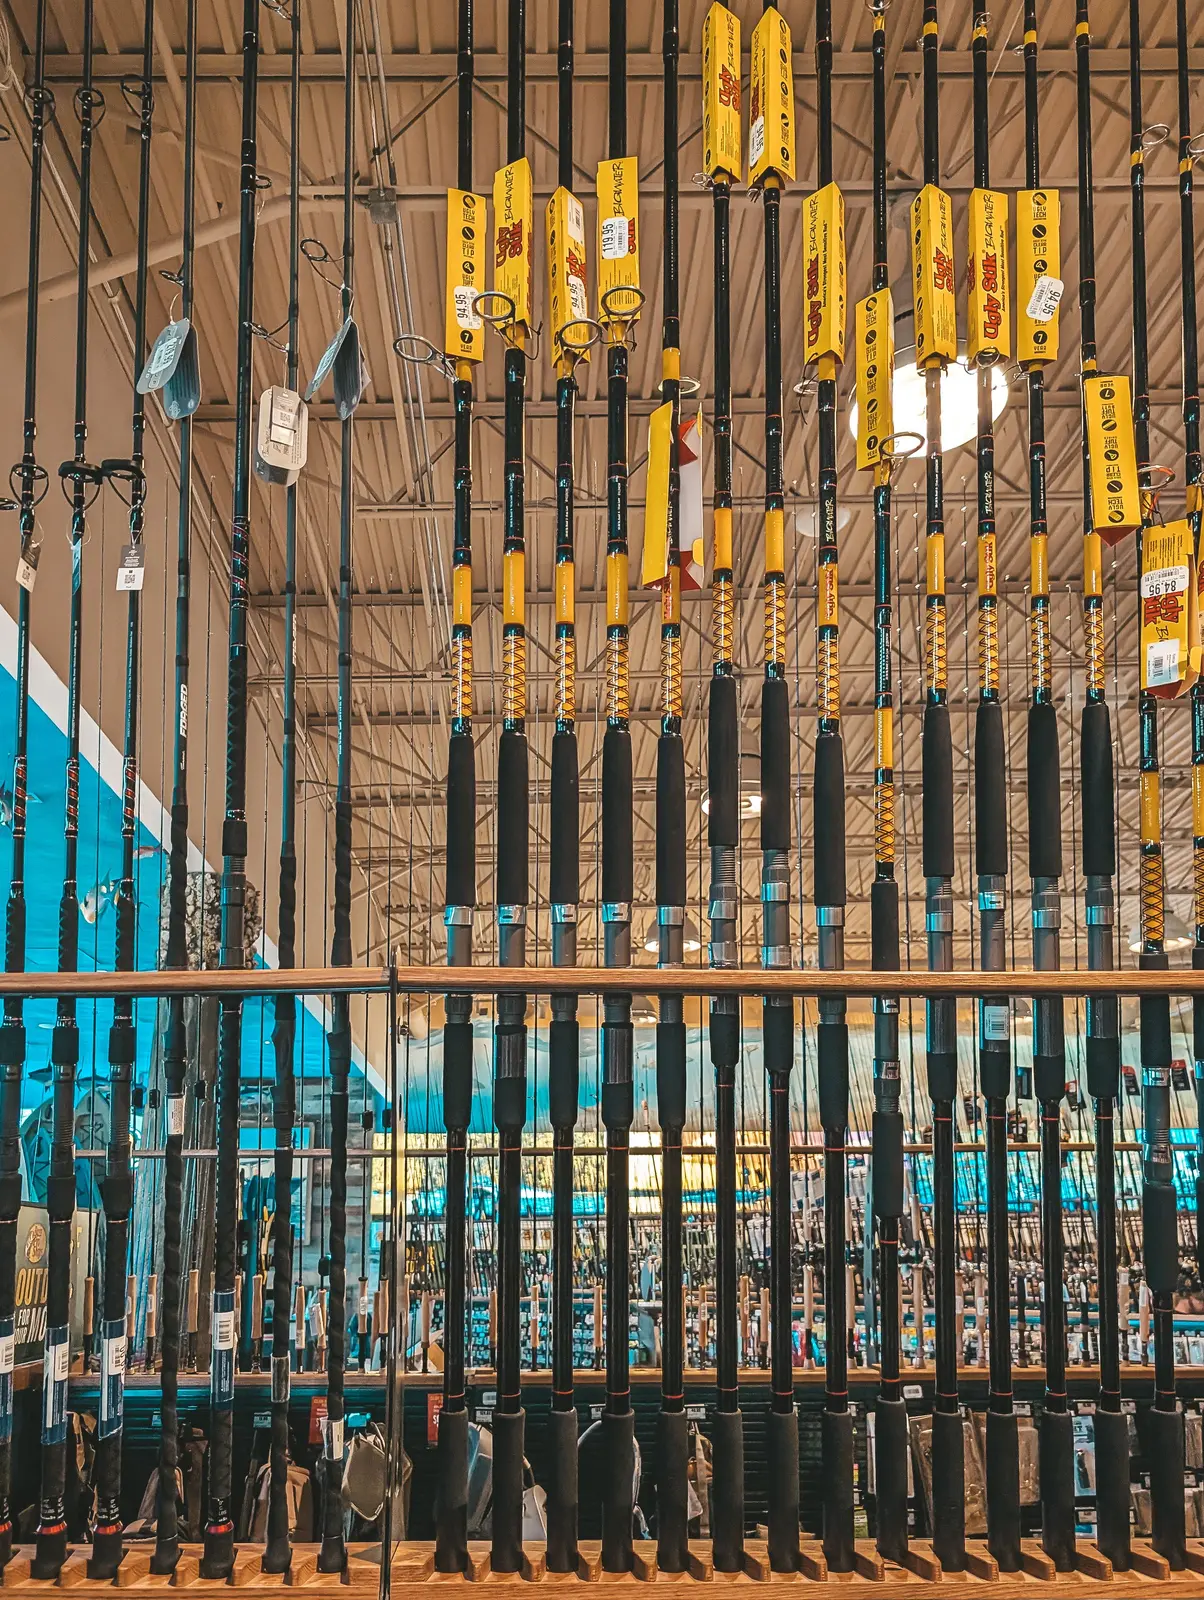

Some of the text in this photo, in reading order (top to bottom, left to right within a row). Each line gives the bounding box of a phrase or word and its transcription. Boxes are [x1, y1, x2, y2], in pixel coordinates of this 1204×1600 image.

[719, 64, 733, 106] Ugly
[1033, 211, 1047, 219] TECH
[496, 226, 510, 269] Ugly
[509, 218, 523, 259] Stik
[602, 223, 614, 253] 119.95
[1033, 247, 1047, 255] TIP
[807, 253, 819, 300] Stik
[932, 246, 947, 290] Ugly
[981, 251, 997, 293] Stik
[455, 293, 468, 320] 94.95
[570, 282, 580, 308] 94.95
[1042, 290, 1061, 316] 94.95
[807, 300, 822, 348] Ugly
[983, 293, 1001, 340] Ugly
[464, 332, 470, 342] 7
[1037, 333, 1043, 343] 7
[1104, 389, 1110, 398] 7
[870, 439, 875, 447] 7
[1149, 580, 1177, 596] 84.95
[179, 684, 188, 738] FORGED
[15, 1268, 49, 1307] OUTD
[18, 1308, 31, 1326] FOR
[26, 1306, 48, 1344] MO
[14, 1327, 28, 1345] OUR
